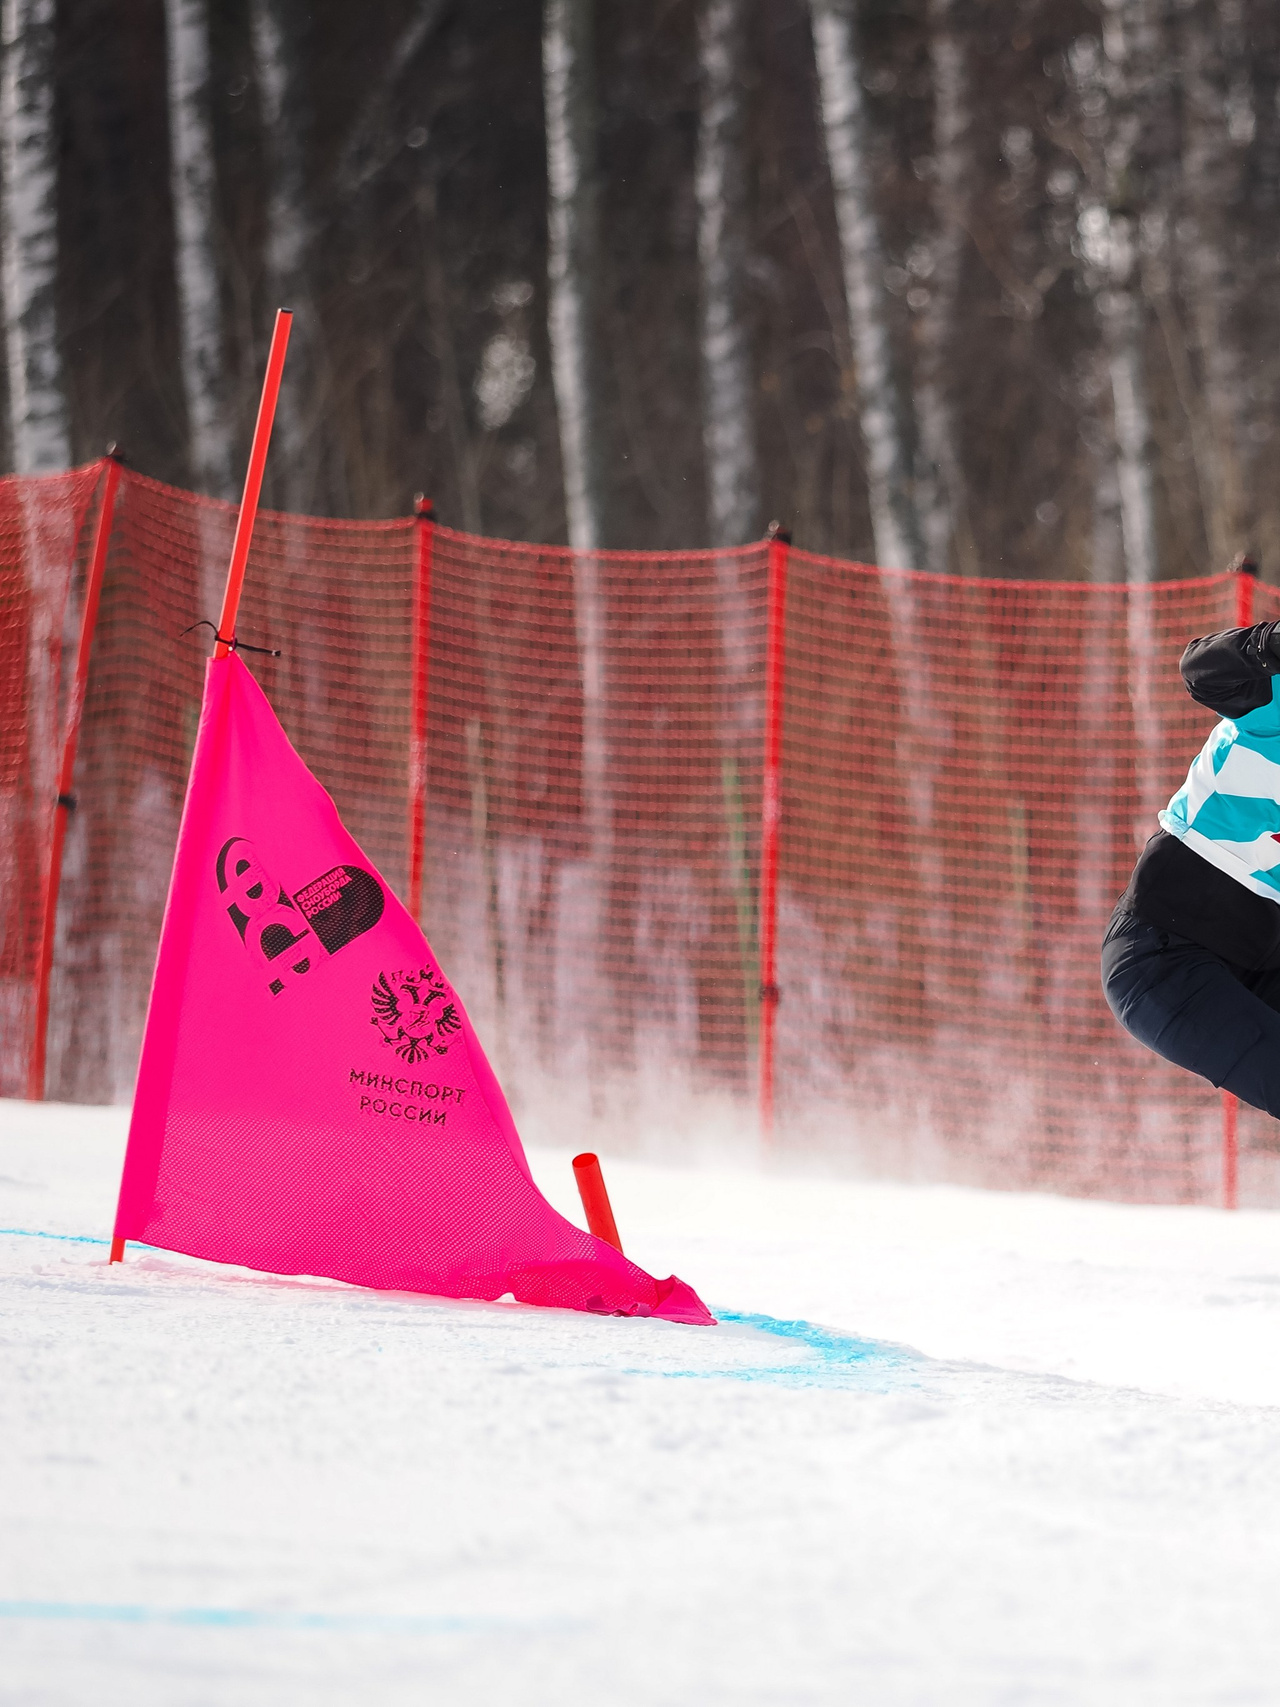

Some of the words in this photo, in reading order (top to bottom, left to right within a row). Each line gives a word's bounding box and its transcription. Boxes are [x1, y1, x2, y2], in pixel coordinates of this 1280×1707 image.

[296, 867, 346, 903] ФЕДЕРАЦИЯ
[301, 874, 353, 911] СНОУБОРДА
[305, 891, 343, 919] РОССИИ
[349, 1068, 466, 1103] МИНСПОРТ
[360, 1095, 447, 1126] РОССИИ
